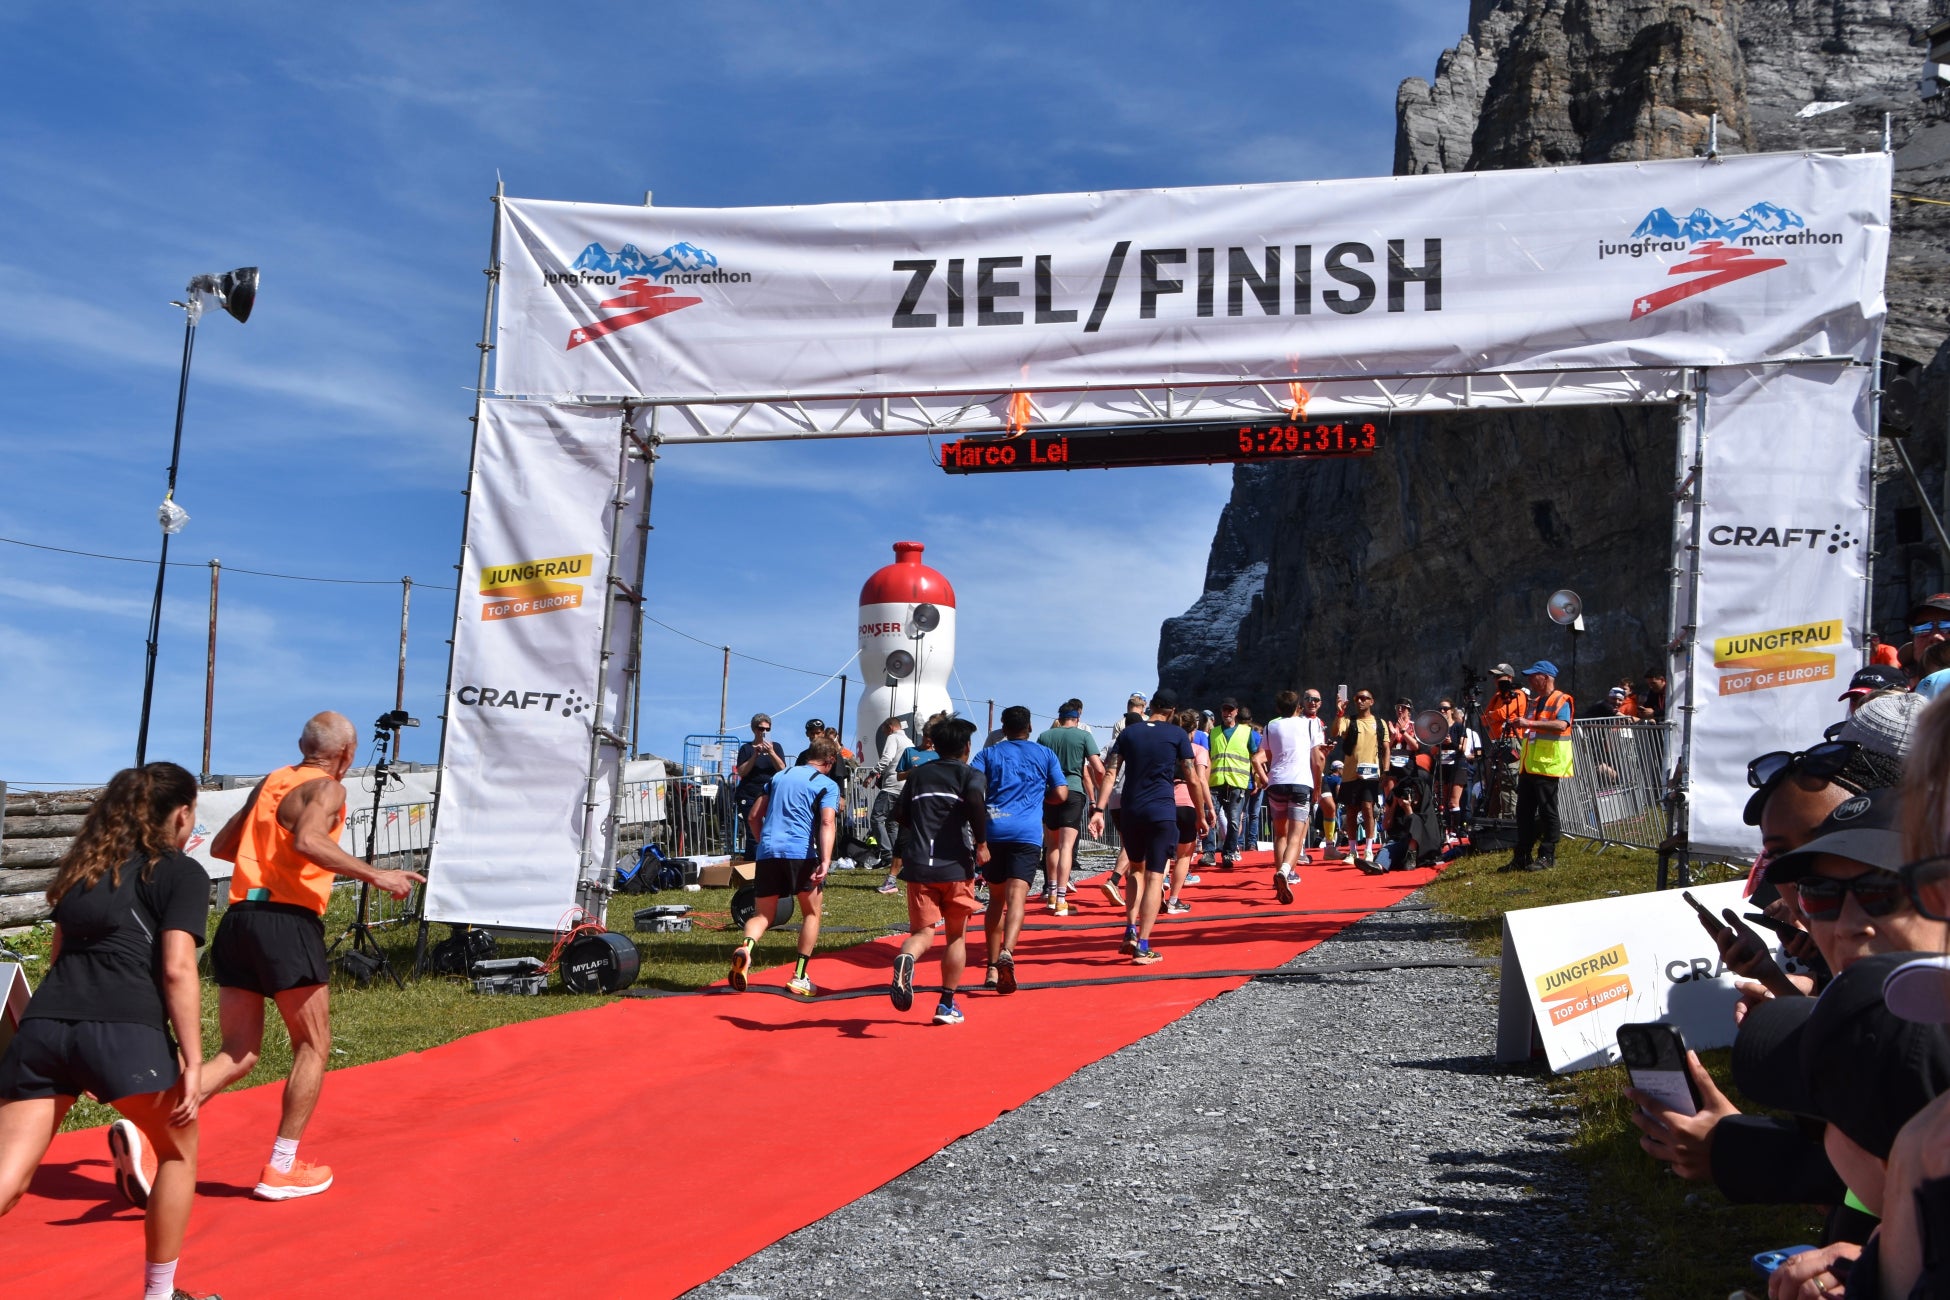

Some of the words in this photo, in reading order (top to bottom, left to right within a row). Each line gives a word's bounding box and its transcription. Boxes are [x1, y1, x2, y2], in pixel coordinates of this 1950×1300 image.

[1599, 237, 1686, 259] jungfrau
[1742, 229, 1843, 246] marathon
[544, 269, 616, 289] jungfrau
[664, 268, 752, 285] marathon
[892, 238, 1442, 332] ZIEL/FINISH
[1239, 423, 1376, 452] 5:29:31,3
[941, 440, 1016, 467] Marco
[1031, 437, 1068, 463] Lei
[1708, 525, 1826, 548] CRAFT
[489, 560, 581, 585] JUNGFRAU
[488, 605, 510, 617] TOP
[513, 602, 530, 613] OF
[533, 595, 577, 611] EUROPE
[859, 622, 901, 638] PONSER
[1725, 625, 1831, 656] JUNGFRAU
[1726, 677, 1751, 690] TOP
[1756, 673, 1774, 685] OF
[1778, 664, 1829, 682] EUROPE
[457, 686, 561, 711] CRAFT
[345, 814, 370, 826] CAFT
[572, 958, 609, 973] MYLAPS
[1545, 950, 1619, 991] JUNGFRAU
[1554, 1004, 1574, 1020] TOP
[1576, 1000, 1589, 1012] OF
[1590, 984, 1628, 1007] EUROPE
